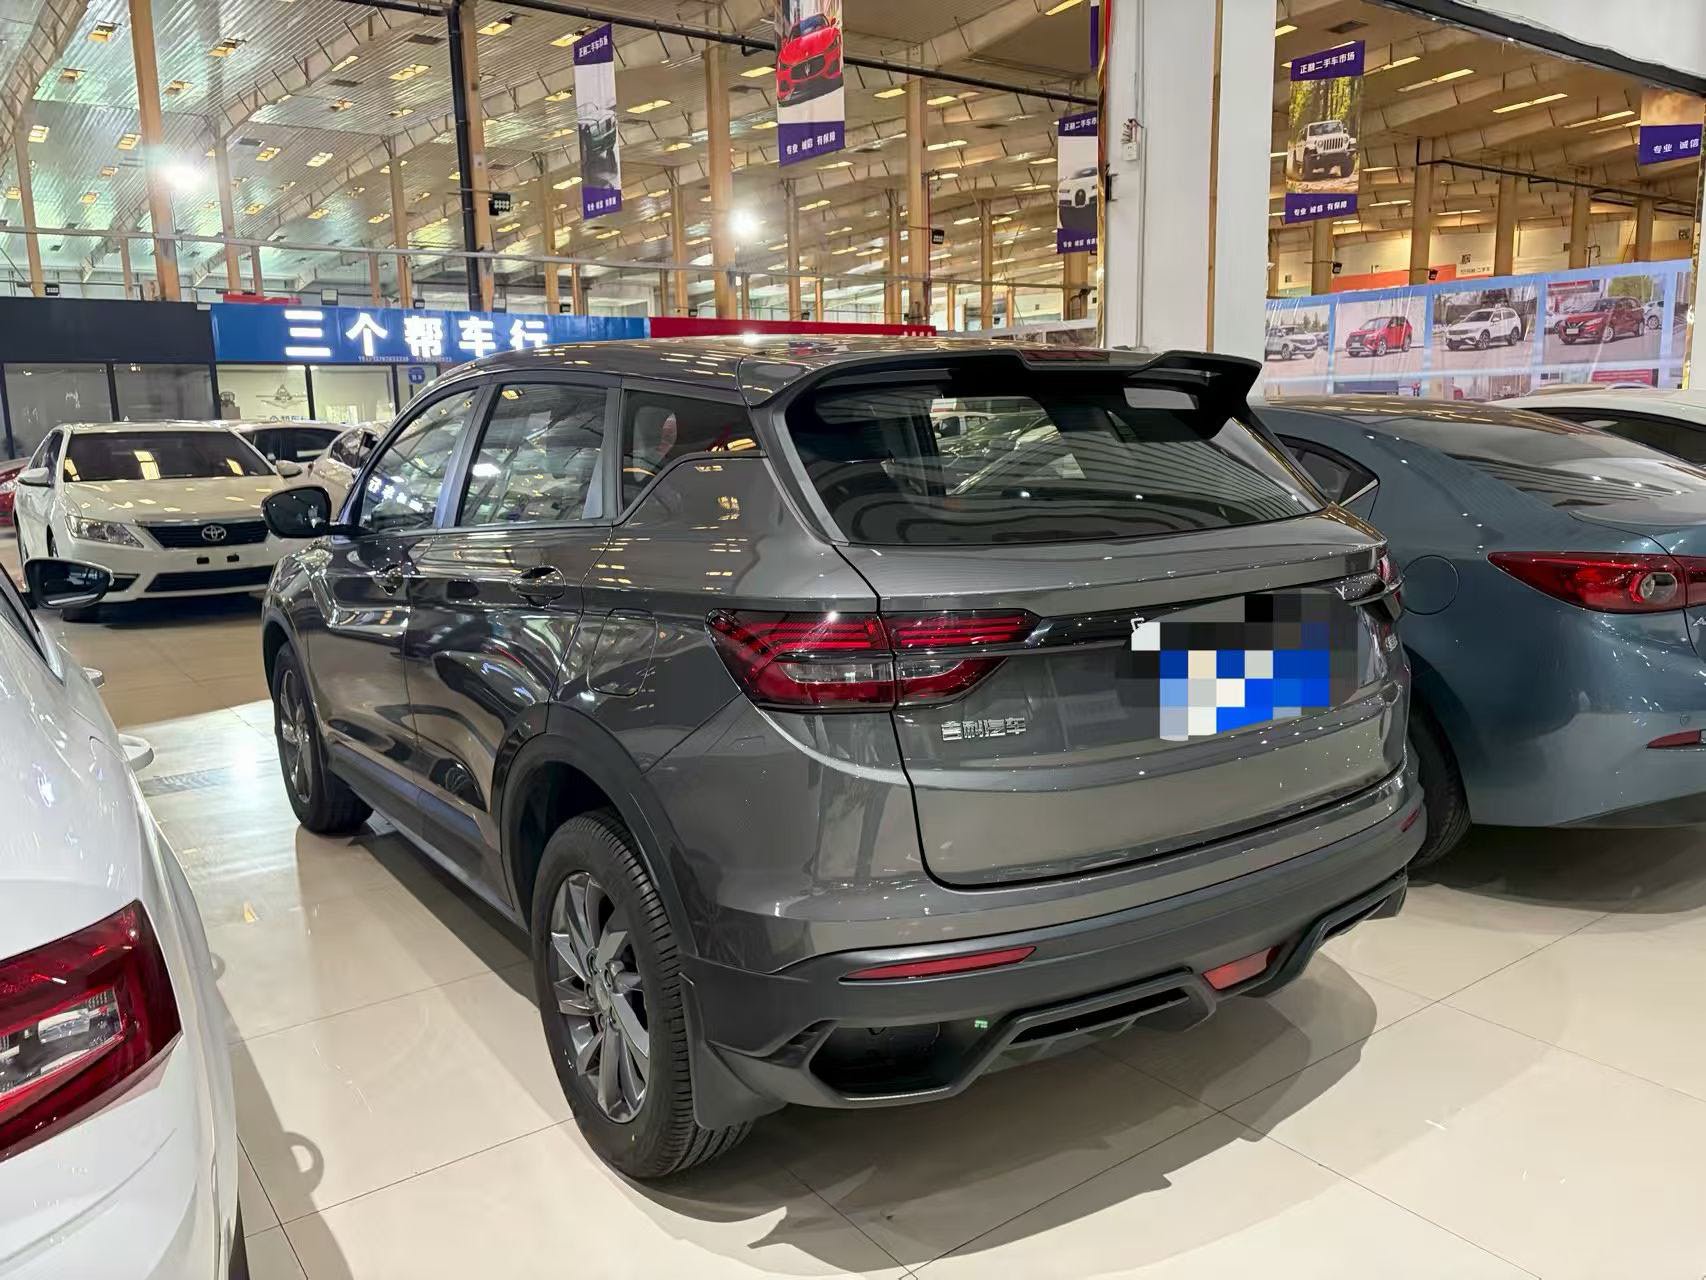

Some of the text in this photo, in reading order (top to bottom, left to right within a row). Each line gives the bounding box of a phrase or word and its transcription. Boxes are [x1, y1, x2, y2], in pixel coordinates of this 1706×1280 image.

[1300, 51, 1355, 74] 正融二手车市场
[786, 144, 798, 155] 专业
[817, 131, 836, 146] 有保障
[1653, 138, 1699, 154] 专业 诚信
[1294, 201, 1347, 216] 专业 诚信 有保障
[284, 309, 549, 358] 三个帮车行
[941, 718, 1026, 740] 吉利汽车
